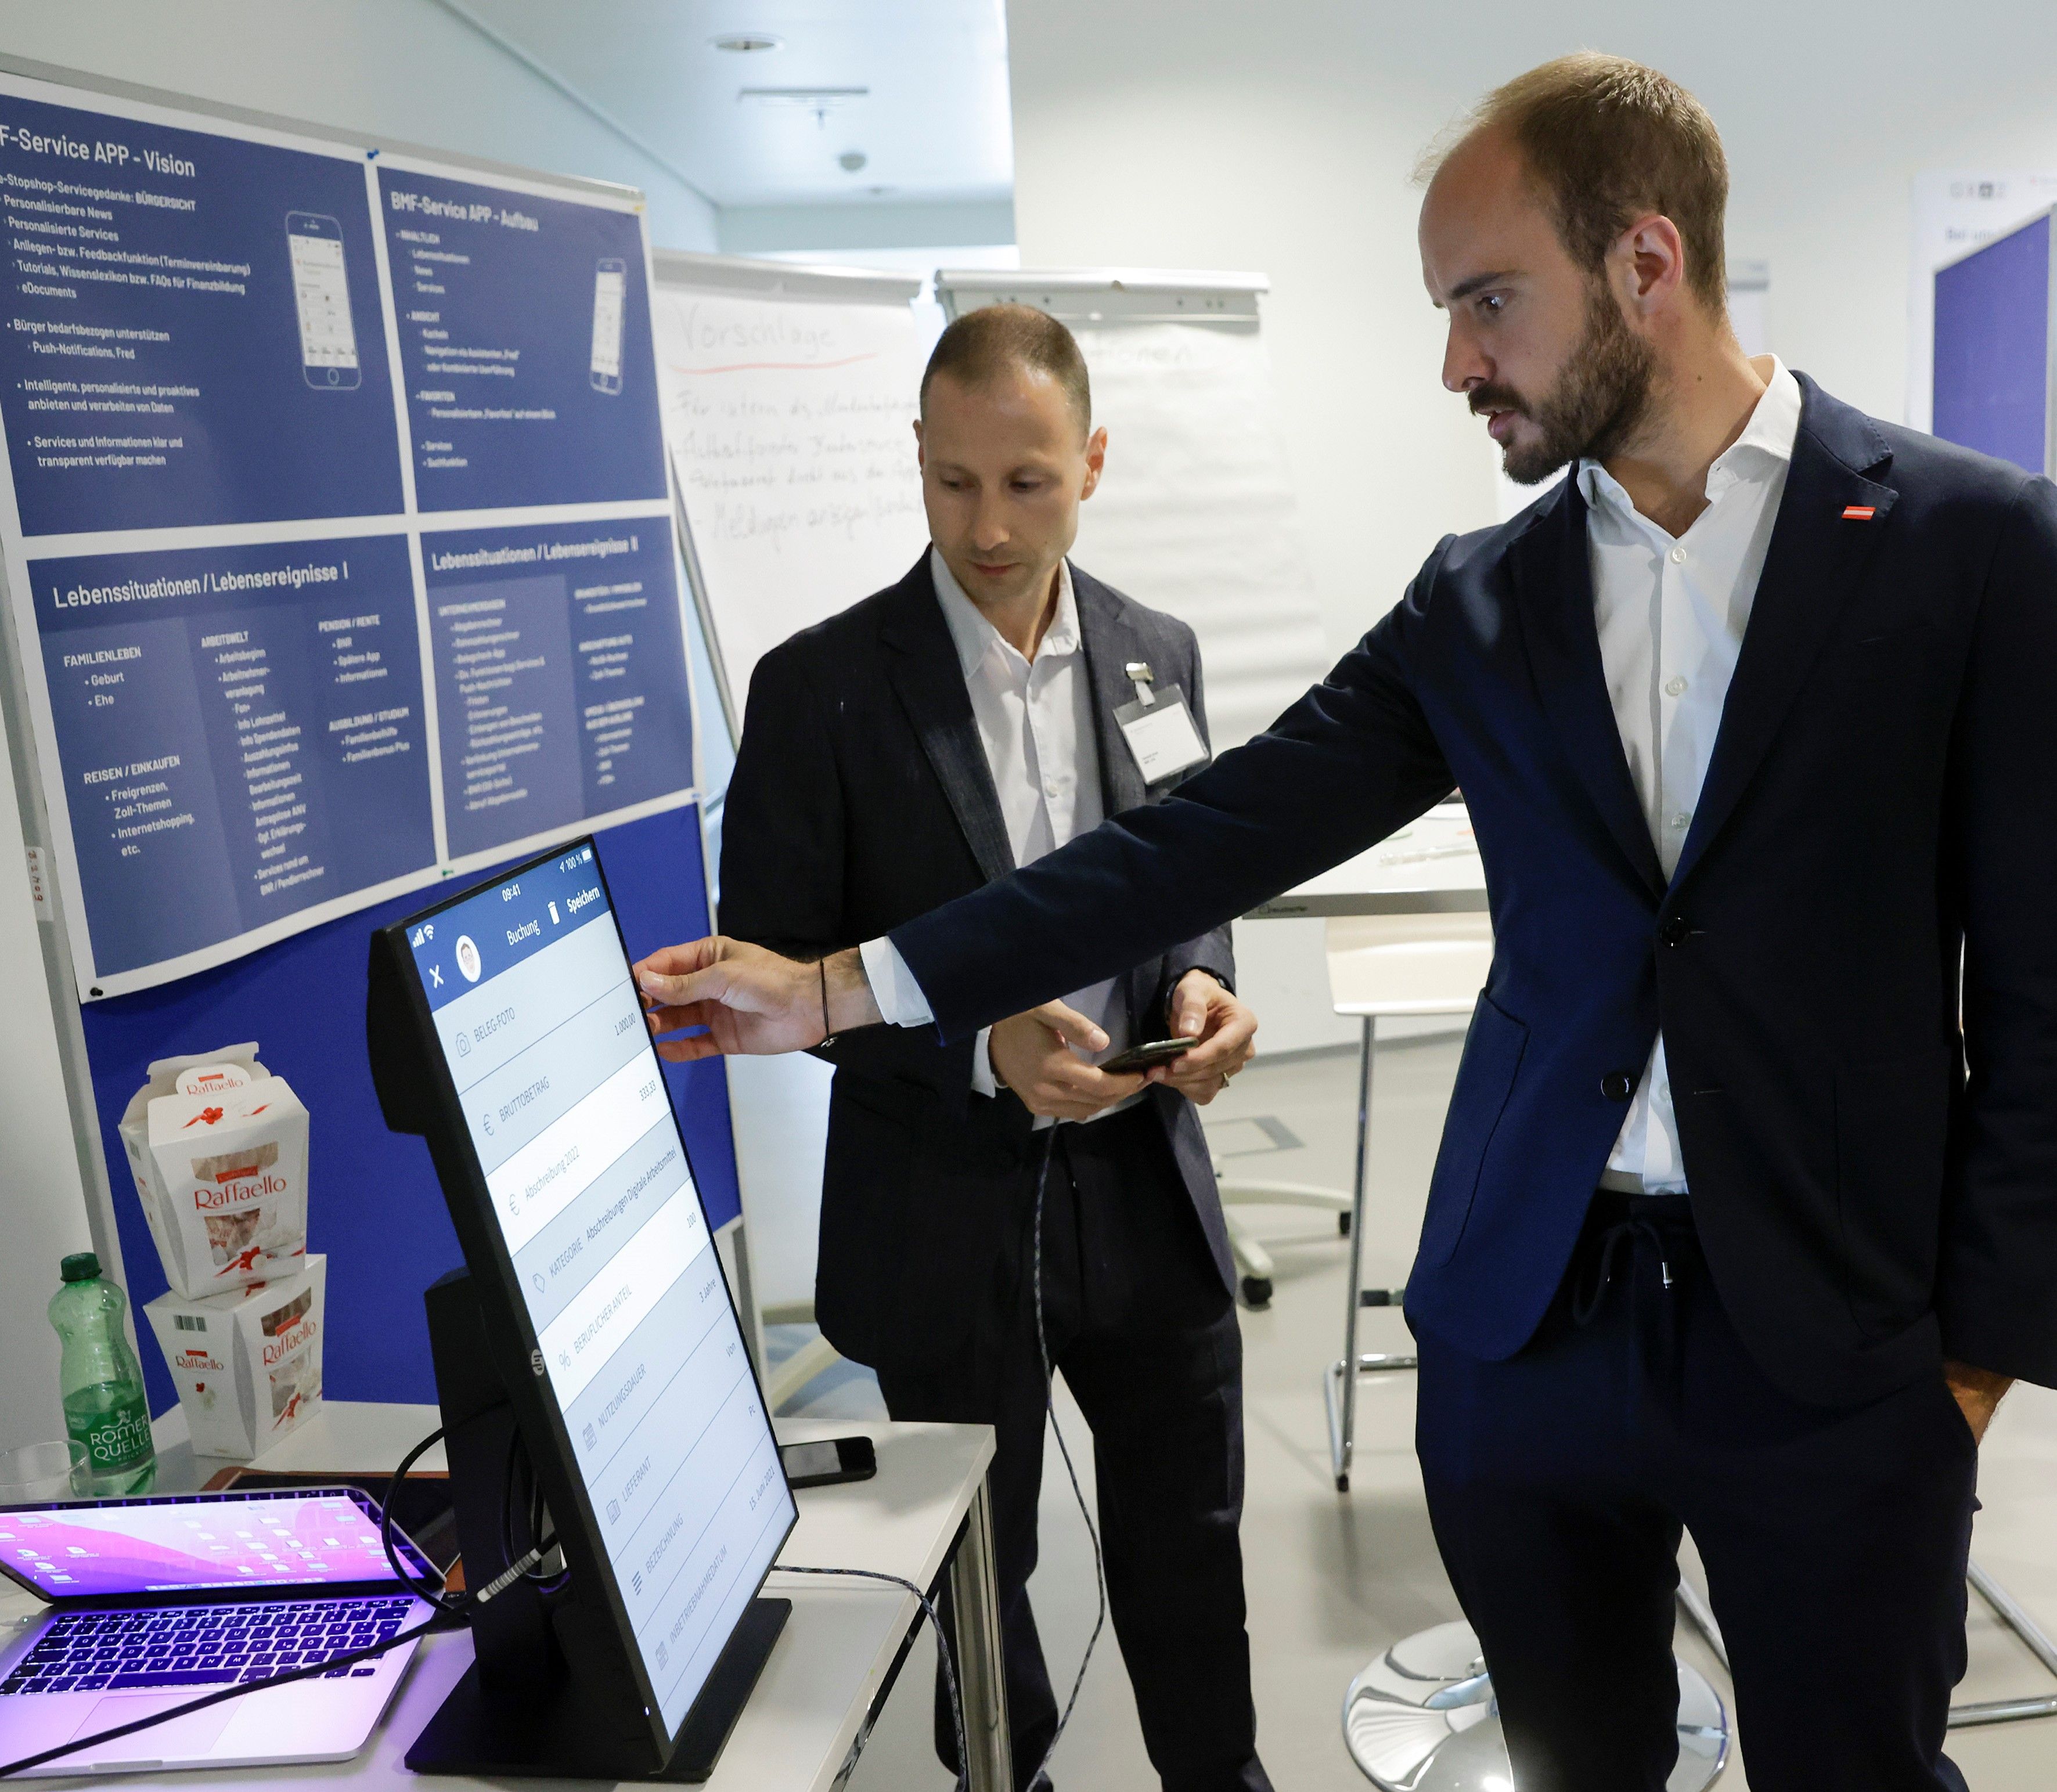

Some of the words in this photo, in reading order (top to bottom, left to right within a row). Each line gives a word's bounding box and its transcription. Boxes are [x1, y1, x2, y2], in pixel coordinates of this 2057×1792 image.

[95, 141, 129, 166] APP
[143, 149, 195, 177] Vision
[3, 194, 86, 217] Personalisierbare
[87, 207, 113, 221] News
[469, 204, 492, 223] APP
[8, 216, 77, 236] Personalisierte
[78, 225, 119, 241] Services
[17, 259, 59, 277] Tutorials,
[59, 265, 128, 283] Wissenslexikon
[173, 276, 185, 288] für
[22, 282, 77, 298] eDocuments
[14, 319, 45, 334] Bürger
[47, 322, 115, 340] bedarfsbezogen
[116, 329, 170, 341] unterstützen
[116, 347, 135, 359] Fred
[81, 383, 141, 395] personalisierte
[142, 384, 157, 395] und
[158, 385, 200, 398] proaktives
[28, 399, 70, 410] anbieten
[71, 401, 87, 410] und
[88, 401, 135, 412] verarbeiten
[136, 403, 150, 412] von
[151, 402, 174, 413] Daten
[34, 436, 77, 448] Services
[78, 437, 94, 448] und
[95, 437, 153, 448] Informationen
[153, 437, 167, 448] klar
[169, 437, 183, 448] und
[38, 455, 93, 468] transparent
[95, 455, 134, 468] verfügbar
[135, 455, 166, 465] machen
[431, 546, 536, 571] Lebenssituationen
[543, 538, 629, 561] Lebensereignisse
[52, 576, 200, 608] Lebenssituationen
[211, 564, 338, 593] Lebensereignisse
[63, 647, 141, 667] FAMILIENLEBEN
[91, 673, 125, 686] Geburt
[95, 694, 114, 706] Ehe
[84, 767, 123, 784] REISEN
[131, 755, 181, 776] EINKAUFEN
[114, 798, 172, 819] Zoll-Themen
[121, 845, 141, 856] etc.
[565, 859, 577, 871] 100
[502, 883, 521, 902] 09:41
[567, 886, 600, 914] Speichern
[506, 919, 541, 946] Buchung
[474, 1007, 516, 1043] BELEG-FOTO
[614, 1012, 636, 1036] 1.000,00
[186, 1078, 243, 1095] Raffaello
[639, 1080, 657, 1101] 333,33
[499, 1076, 550, 1123] BRUTTOBETRAG
[524, 1160, 567, 1201] Abschreibung
[566, 1145, 580, 1166] 2022
[194, 1174, 288, 1210] Raffaello
[549, 1236, 584, 1279] KATEGORIE
[586, 1195, 629, 1242] Abschreibungen
[626, 1176, 647, 1202] Digitale
[646, 1145, 677, 1183] Arbeitsmittel
[686, 1212, 697, 1229] 100
[704, 1278, 716, 1299] Jahre
[574, 1304, 614, 1354] BERUFLICHER
[613, 1283, 632, 1313] ANTEIL
[262, 1321, 317, 1366] Raffaello
[175, 1355, 224, 1371] Raffaello
[597, 1363, 647, 1430] NUTZUNGSDAUER
[94, 1429, 150, 1461] QUELLE
[622, 1455, 652, 1502] LIEFERANT
[646, 1515, 685, 1574] BEZEICHNUNG
